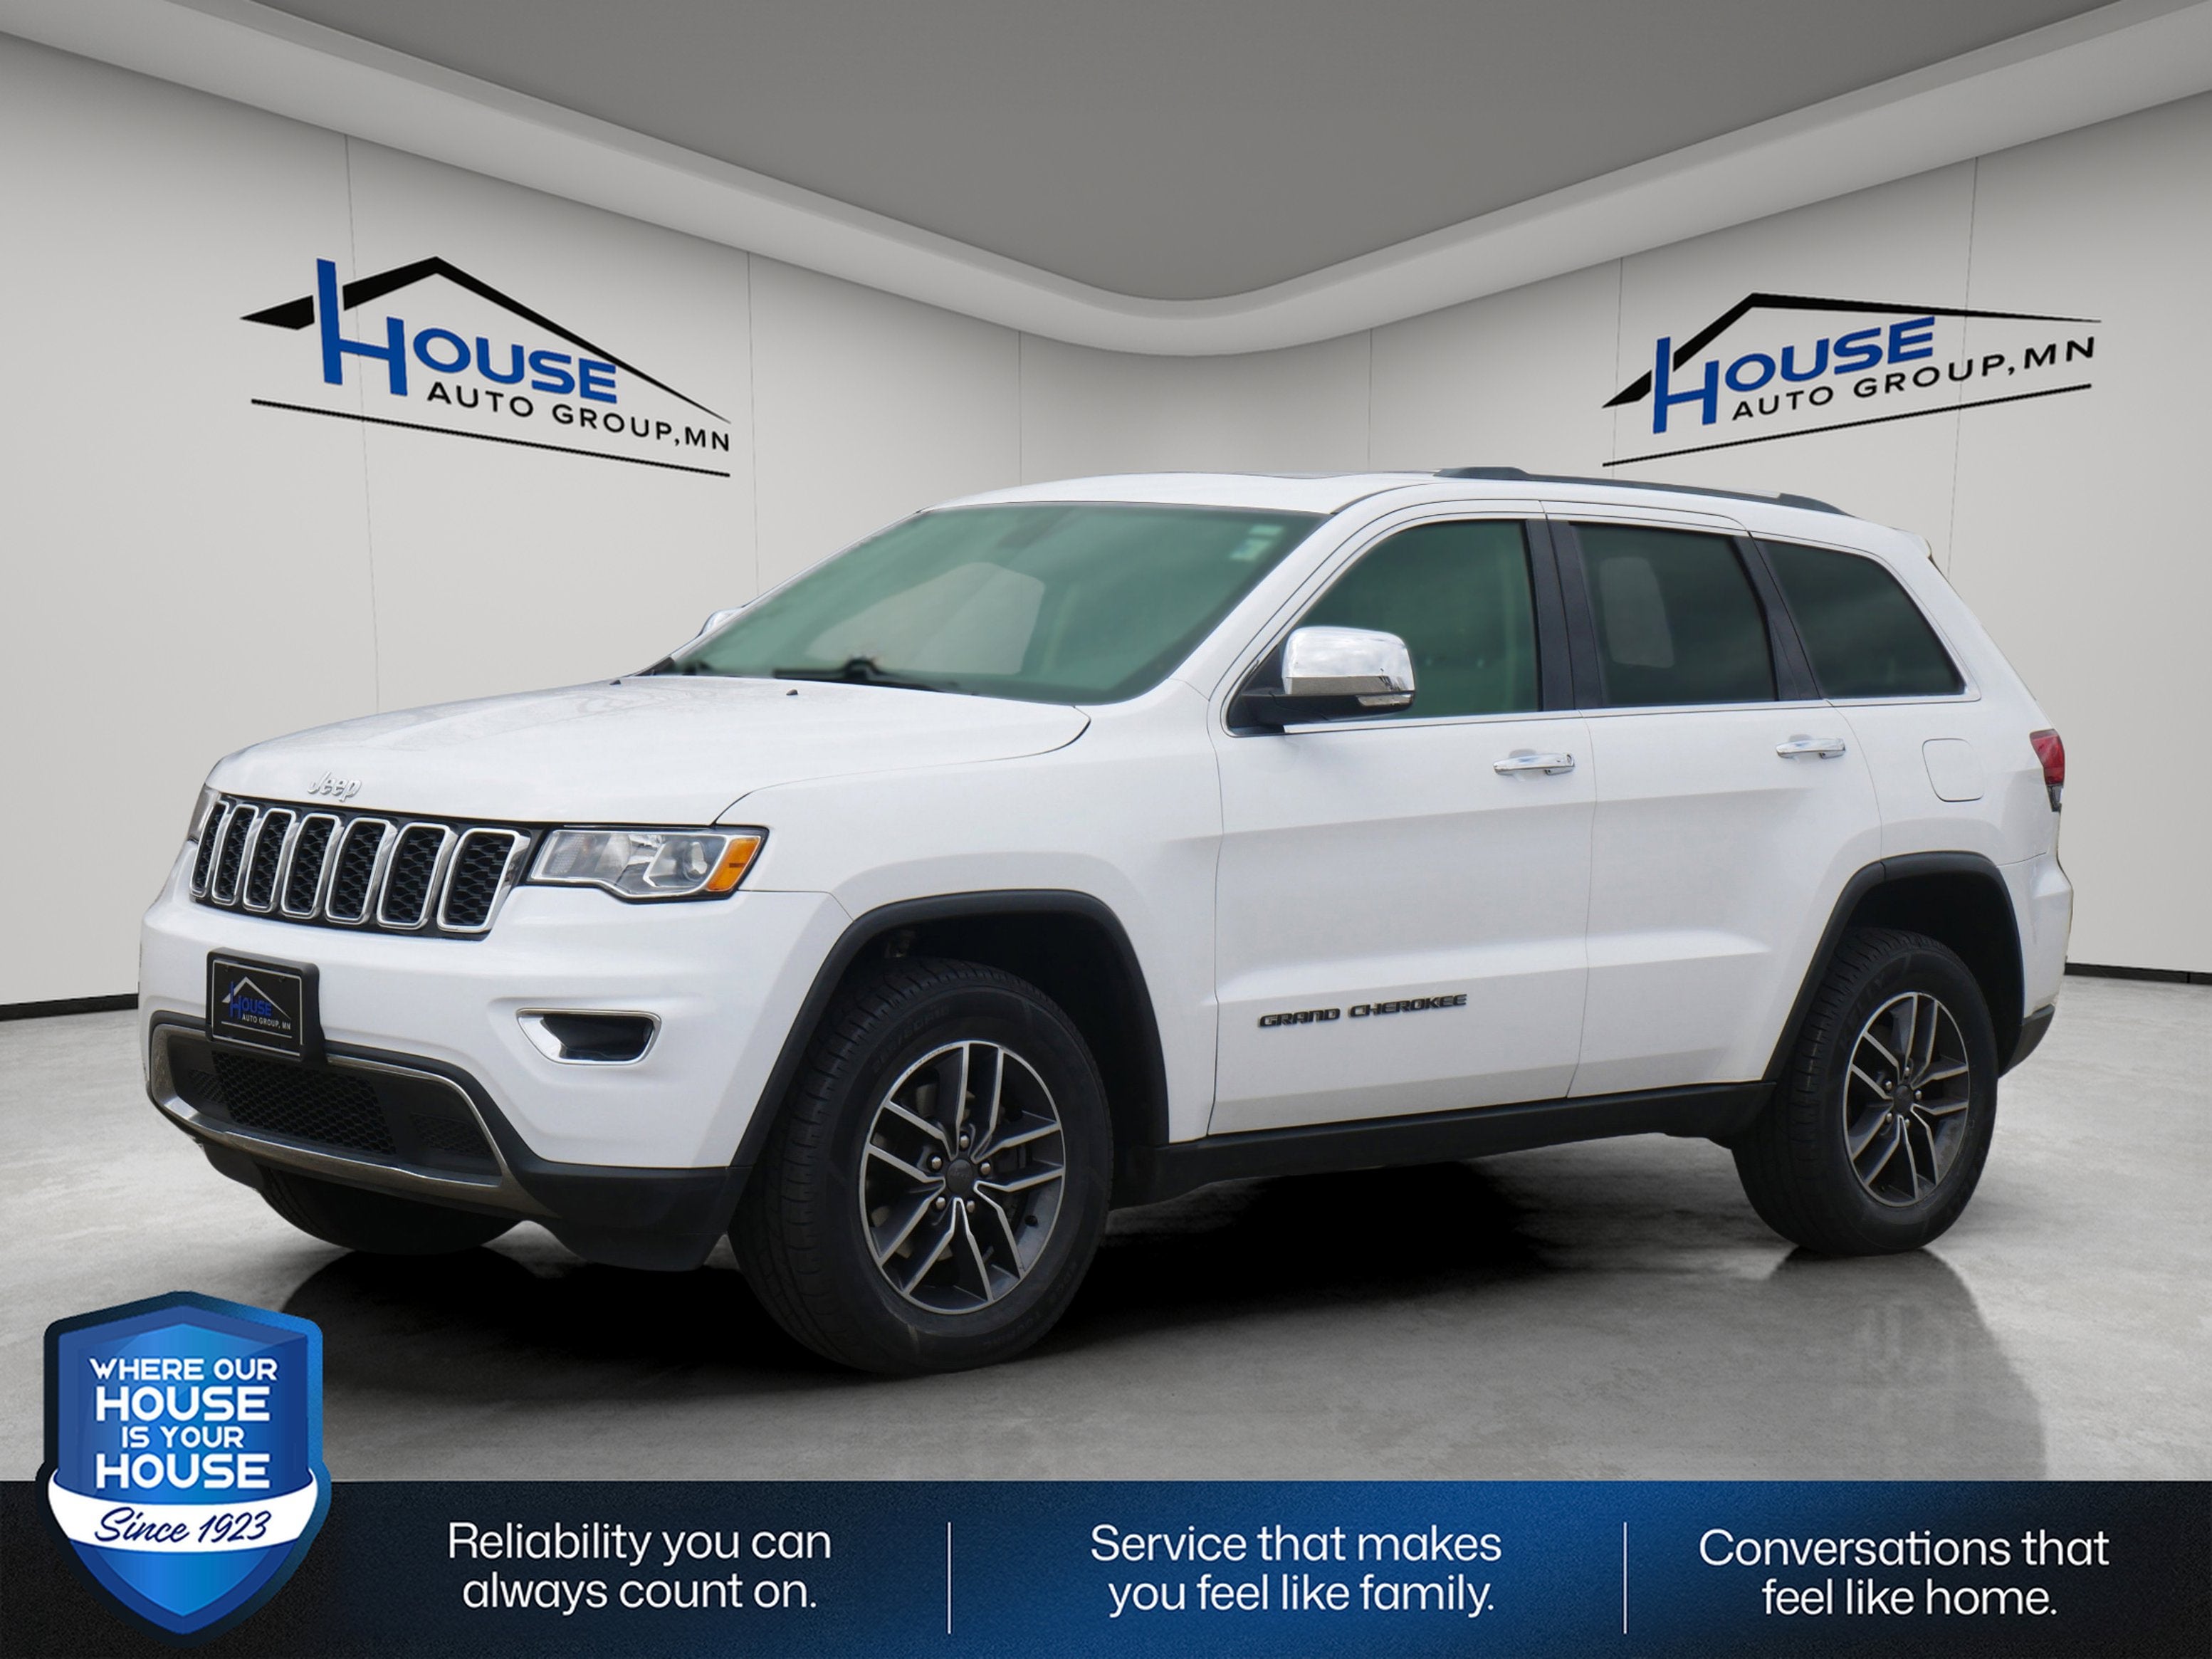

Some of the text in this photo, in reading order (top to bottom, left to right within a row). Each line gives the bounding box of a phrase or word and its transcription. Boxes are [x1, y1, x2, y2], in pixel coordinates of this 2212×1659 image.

[317, 258, 617, 404] HOUSE
[1652, 316, 1934, 434] HOUSE
[426, 381, 534, 418] AUTO
[1731, 385, 1834, 421] AUTO
[307, 770, 362, 802] Jeep
[229, 981, 272, 1019] HOUSE
[1258, 993, 1467, 1028] GRAND CHEROKEE
[241, 1013, 257, 1024] AUTO
